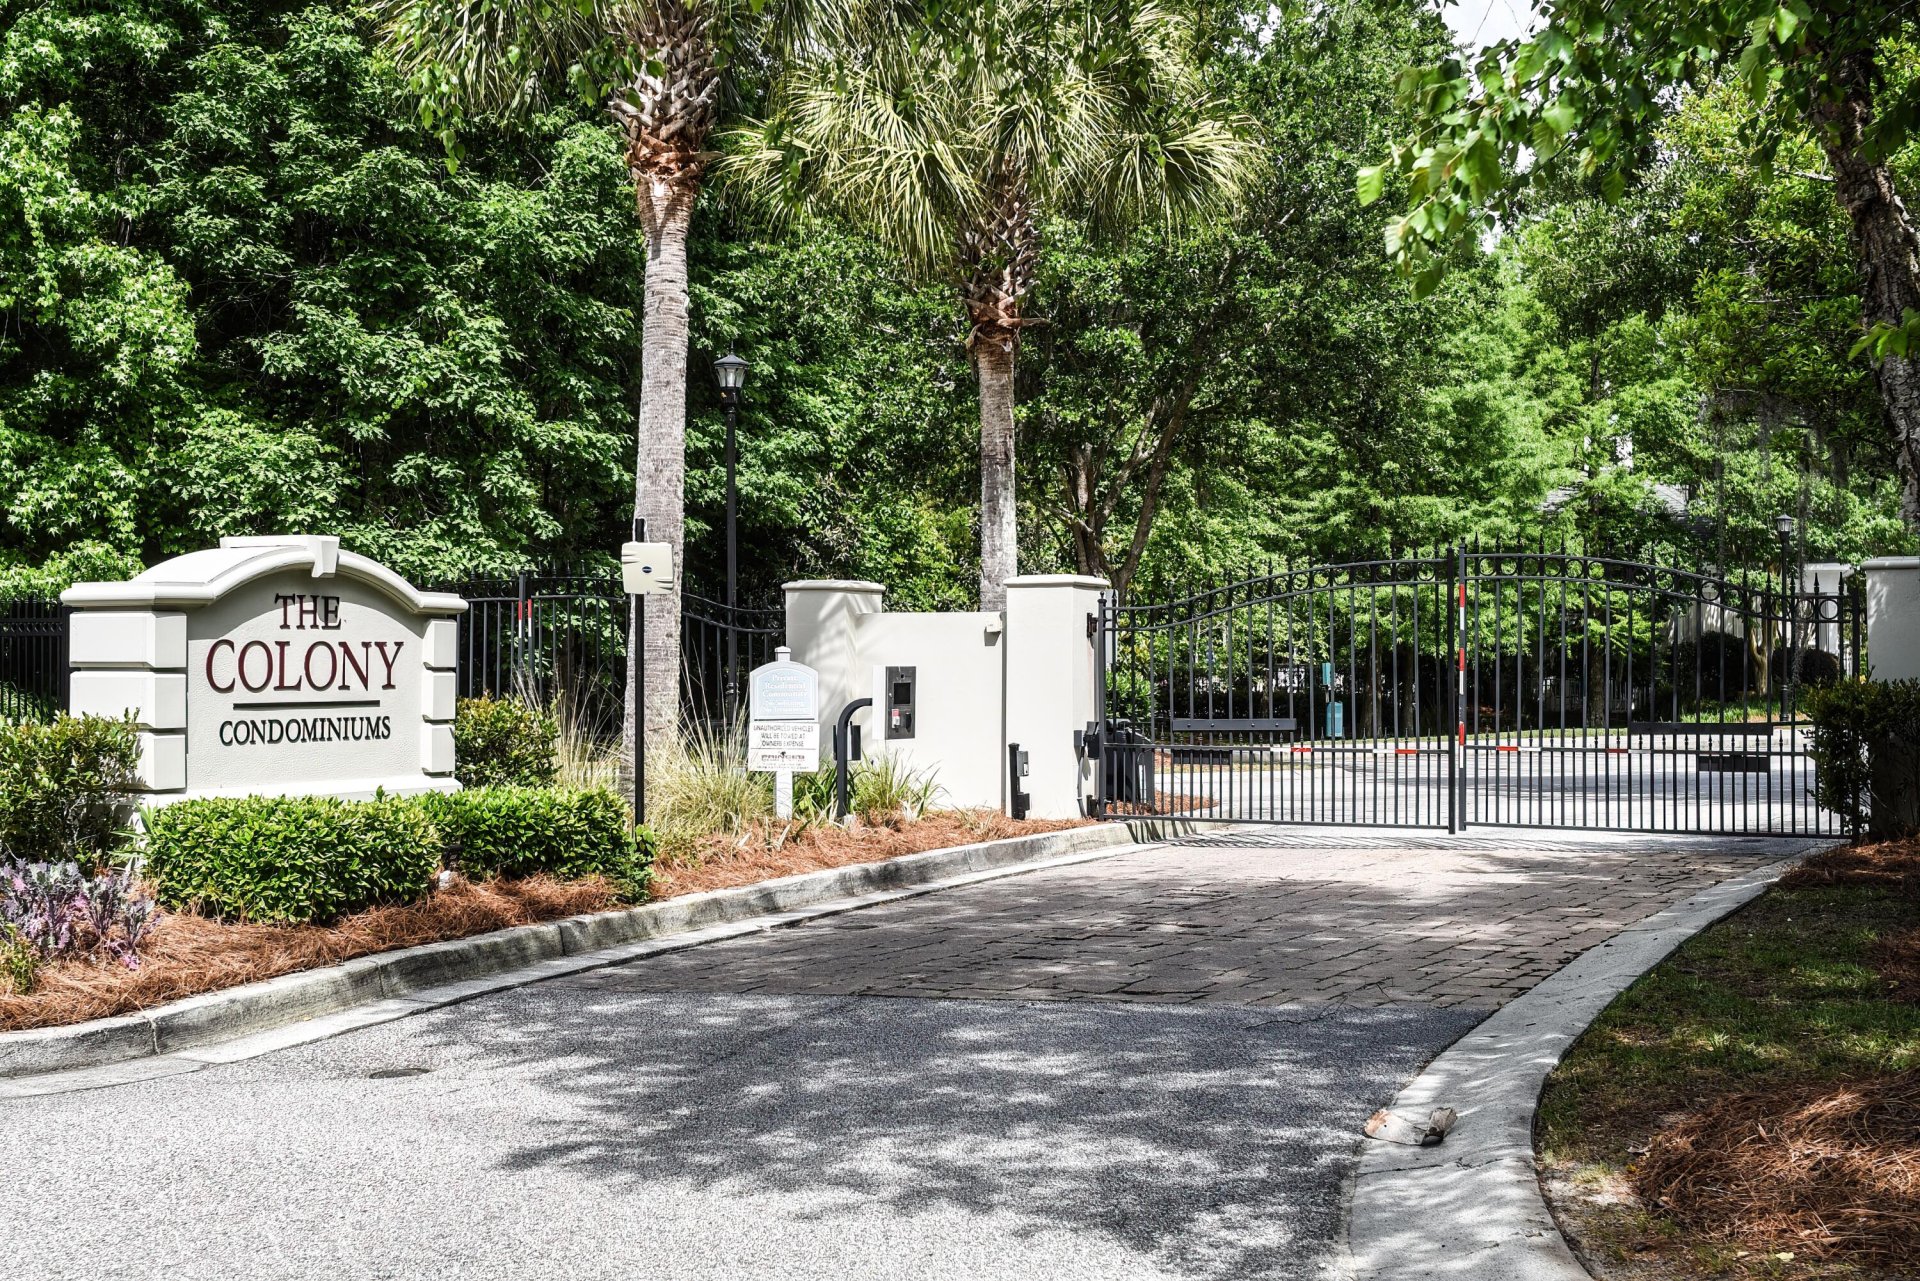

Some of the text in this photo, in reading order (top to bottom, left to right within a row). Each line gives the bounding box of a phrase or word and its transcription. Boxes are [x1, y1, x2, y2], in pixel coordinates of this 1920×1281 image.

[275, 593, 341, 630] THE
[206, 639, 404, 694] COLONY
[763, 689, 808, 698] Community
[219, 716, 391, 747] CONDOMINIUMS
